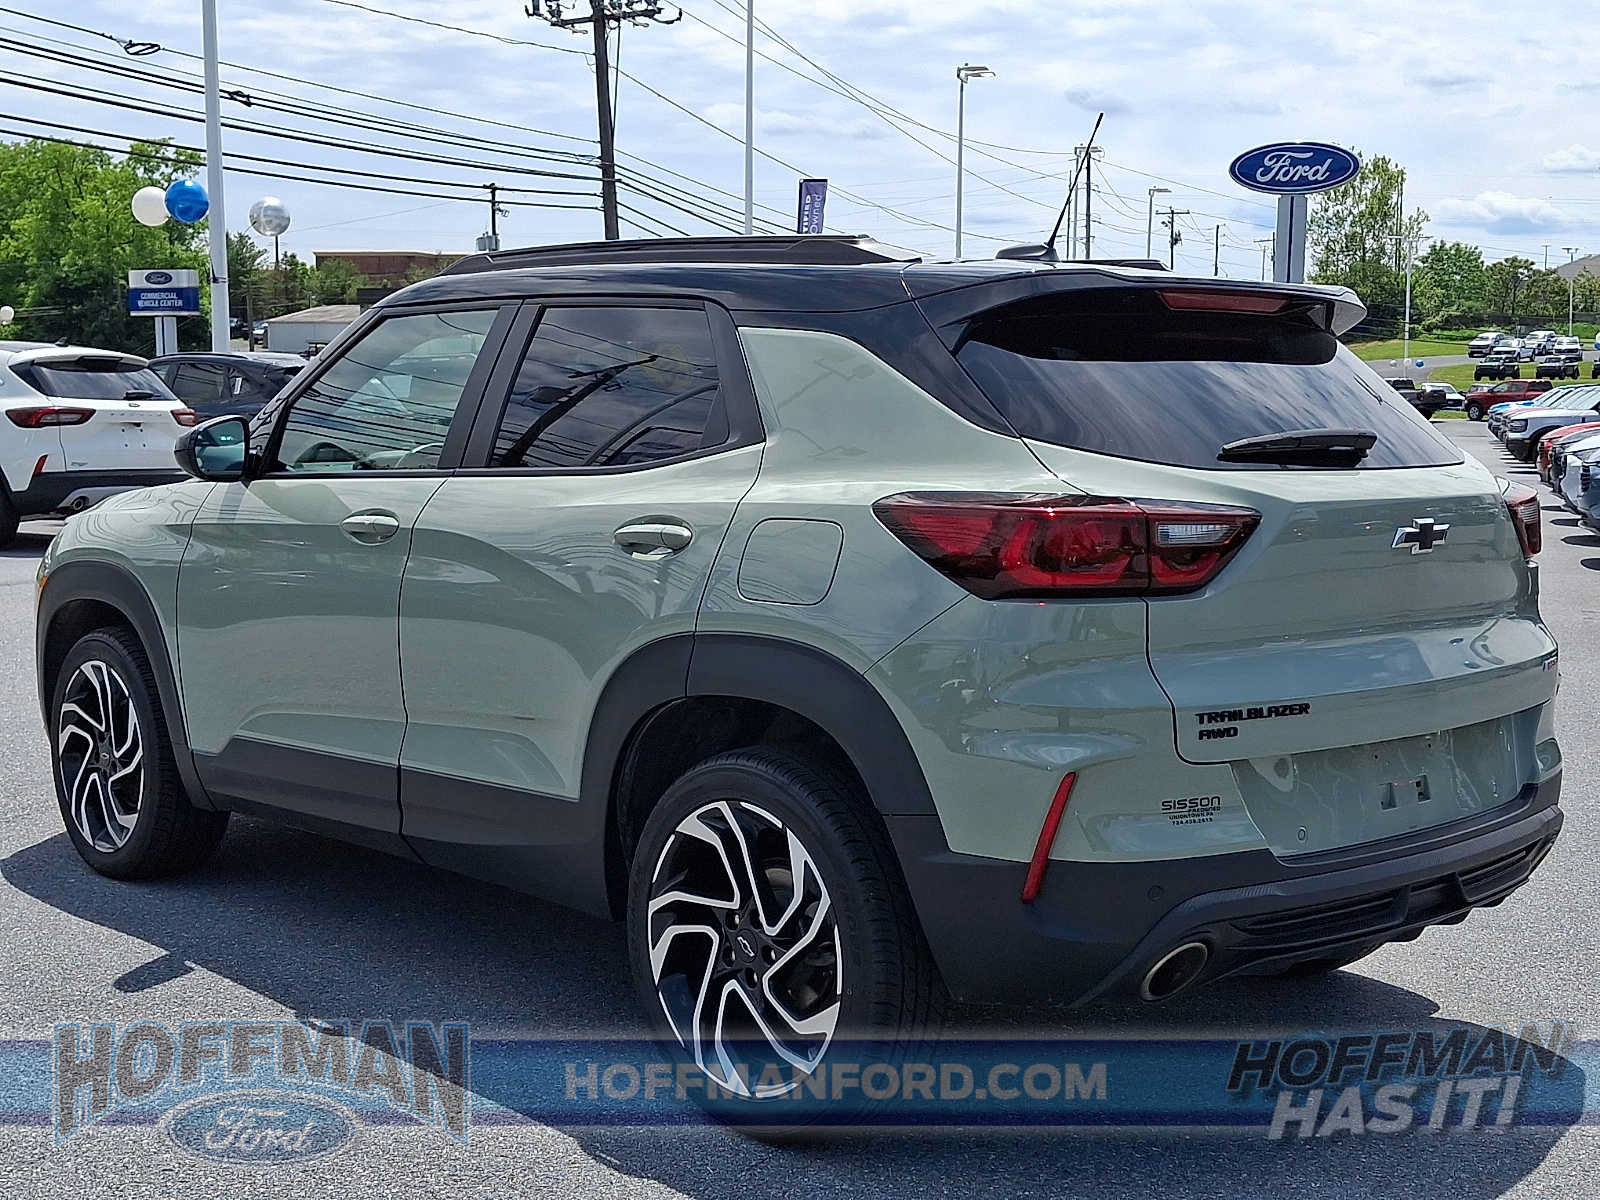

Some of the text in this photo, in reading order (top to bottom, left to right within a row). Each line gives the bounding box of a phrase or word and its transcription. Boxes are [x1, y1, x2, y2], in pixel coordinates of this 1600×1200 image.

[1255, 151, 1334, 183] Ford
[1195, 702, 1311, 725] TRAILBLAZER
[1198, 726, 1239, 741] AWD
